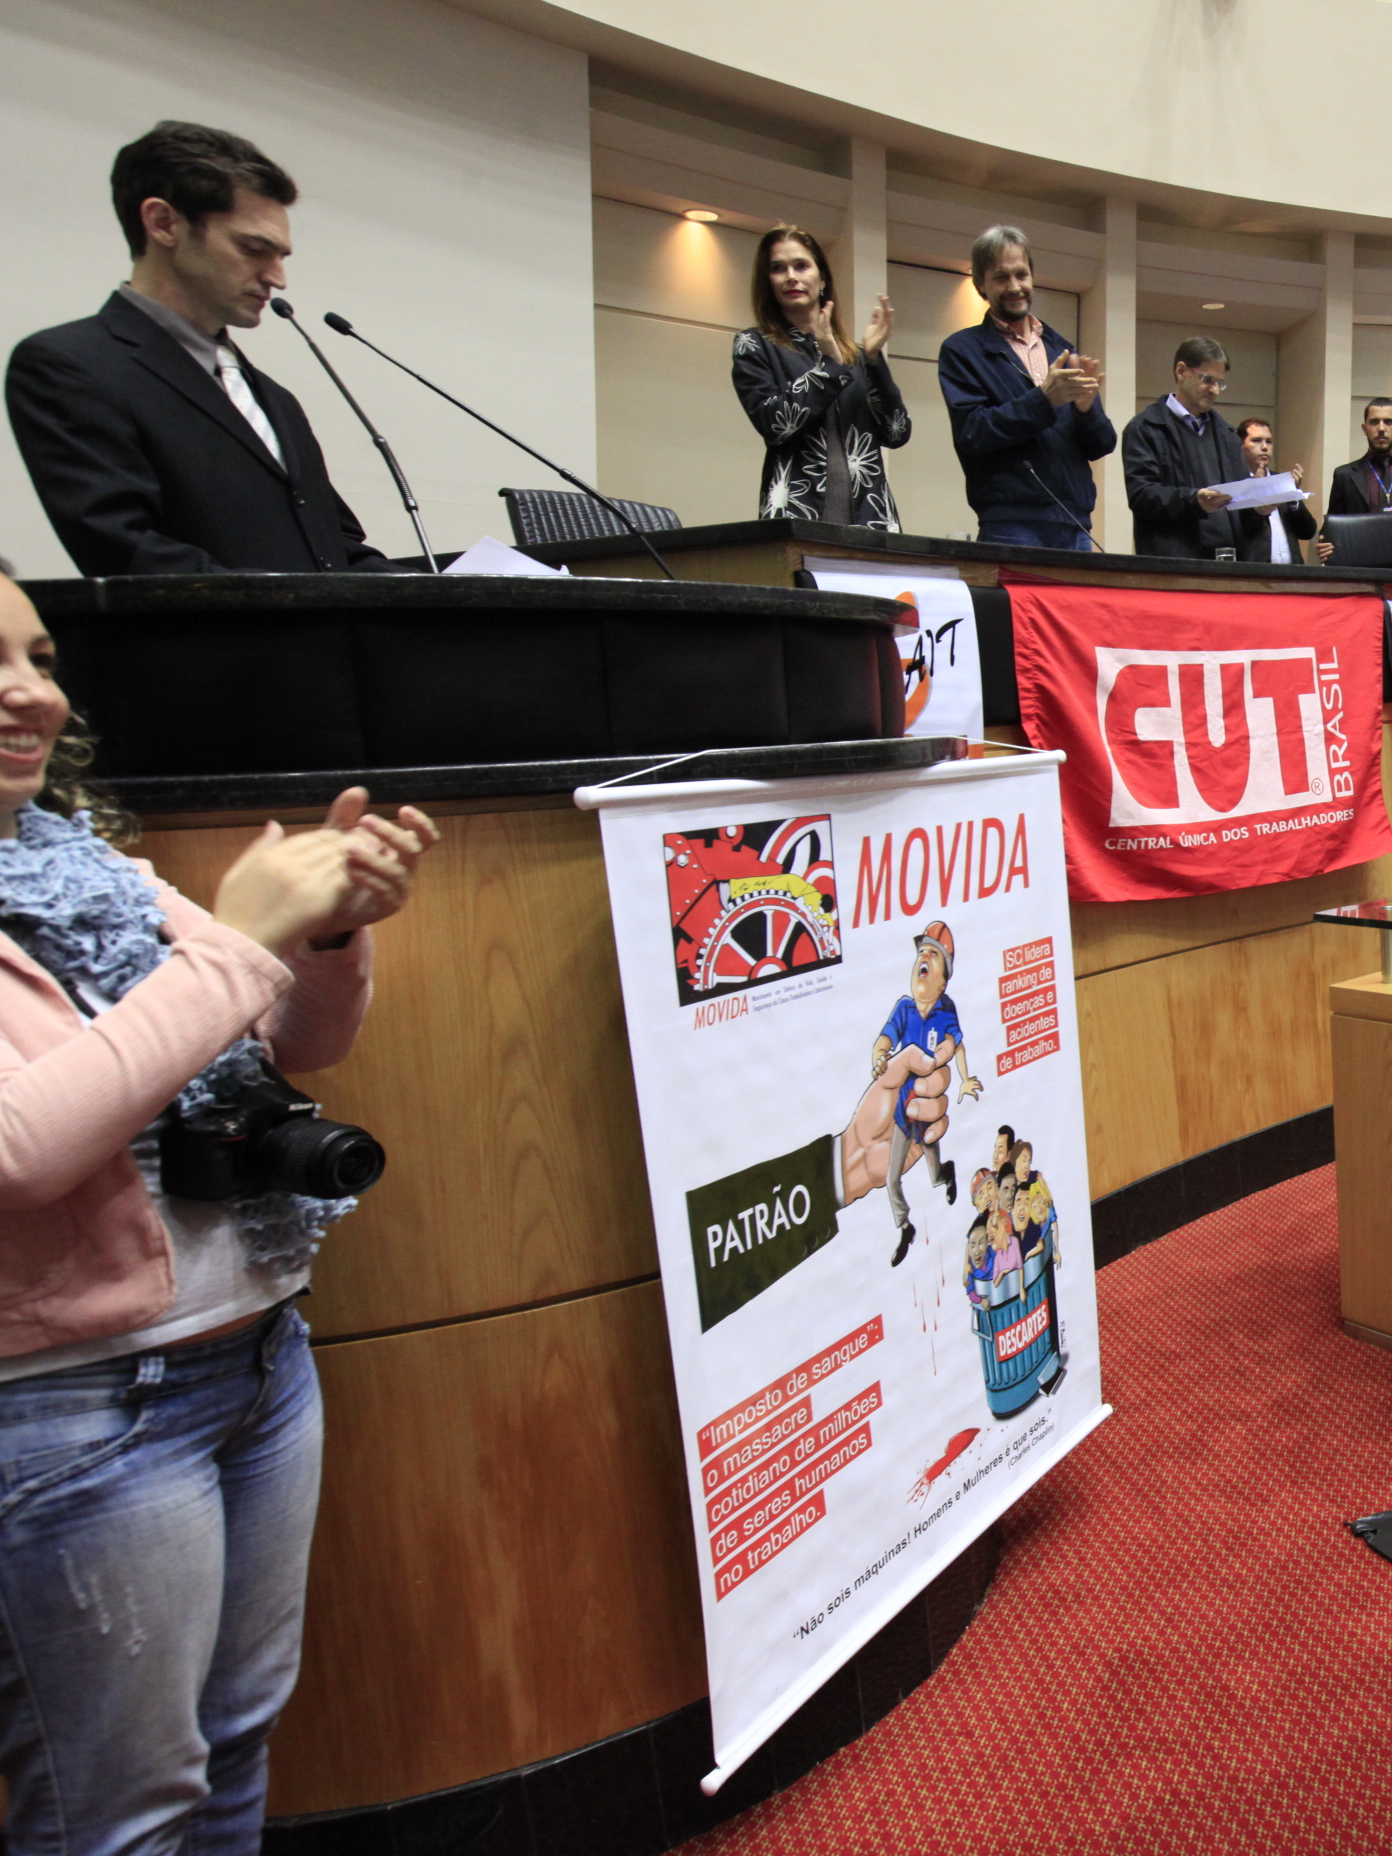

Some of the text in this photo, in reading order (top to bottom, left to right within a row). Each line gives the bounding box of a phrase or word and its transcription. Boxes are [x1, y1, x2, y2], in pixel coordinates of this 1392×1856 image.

[1105, 656, 1317, 813] CUT
[1319, 647, 1355, 798] BRASIL
[1104, 809, 1355, 850] CENTRAL ÚNICA DOS TRABALHADORES
[852, 813, 1030, 929] MOVIDA
[1001, 966, 1052, 996] ranking de
[1006, 943, 1050, 968] SC lidera
[694, 995, 748, 1030] MOVIDA
[1004, 991, 1054, 1019] doenças e
[1009, 1014, 1055, 1042] acidentes
[1000, 1038, 1057, 1072] de trabalho.
[707, 1184, 811, 1268] PATRÃO
[999, 1304, 1047, 1357] DESCARTES
[703, 1388, 782, 1446] “Imposto
[786, 1372, 808, 1395] de
[1008, 1422, 1055, 1470] (Charles Chaplin)
[707, 1408, 807, 1487] o massacre
[711, 1392, 878, 1522] cotidiano de milhões
[716, 1433, 867, 1557] de seres humanos
[720, 1506, 820, 1592] no trabalho.
[793, 1611, 825, 1639] “Não
[827, 1587, 851, 1615] sois
[854, 1532, 911, 1591] máquinas!
[913, 1497, 953, 1538] Homens
[955, 1490, 961, 1501] e
[963, 1452, 1004, 1494] Mulheres
[1005, 1444, 1011, 1457] é
[1013, 1432, 1027, 1451] que
